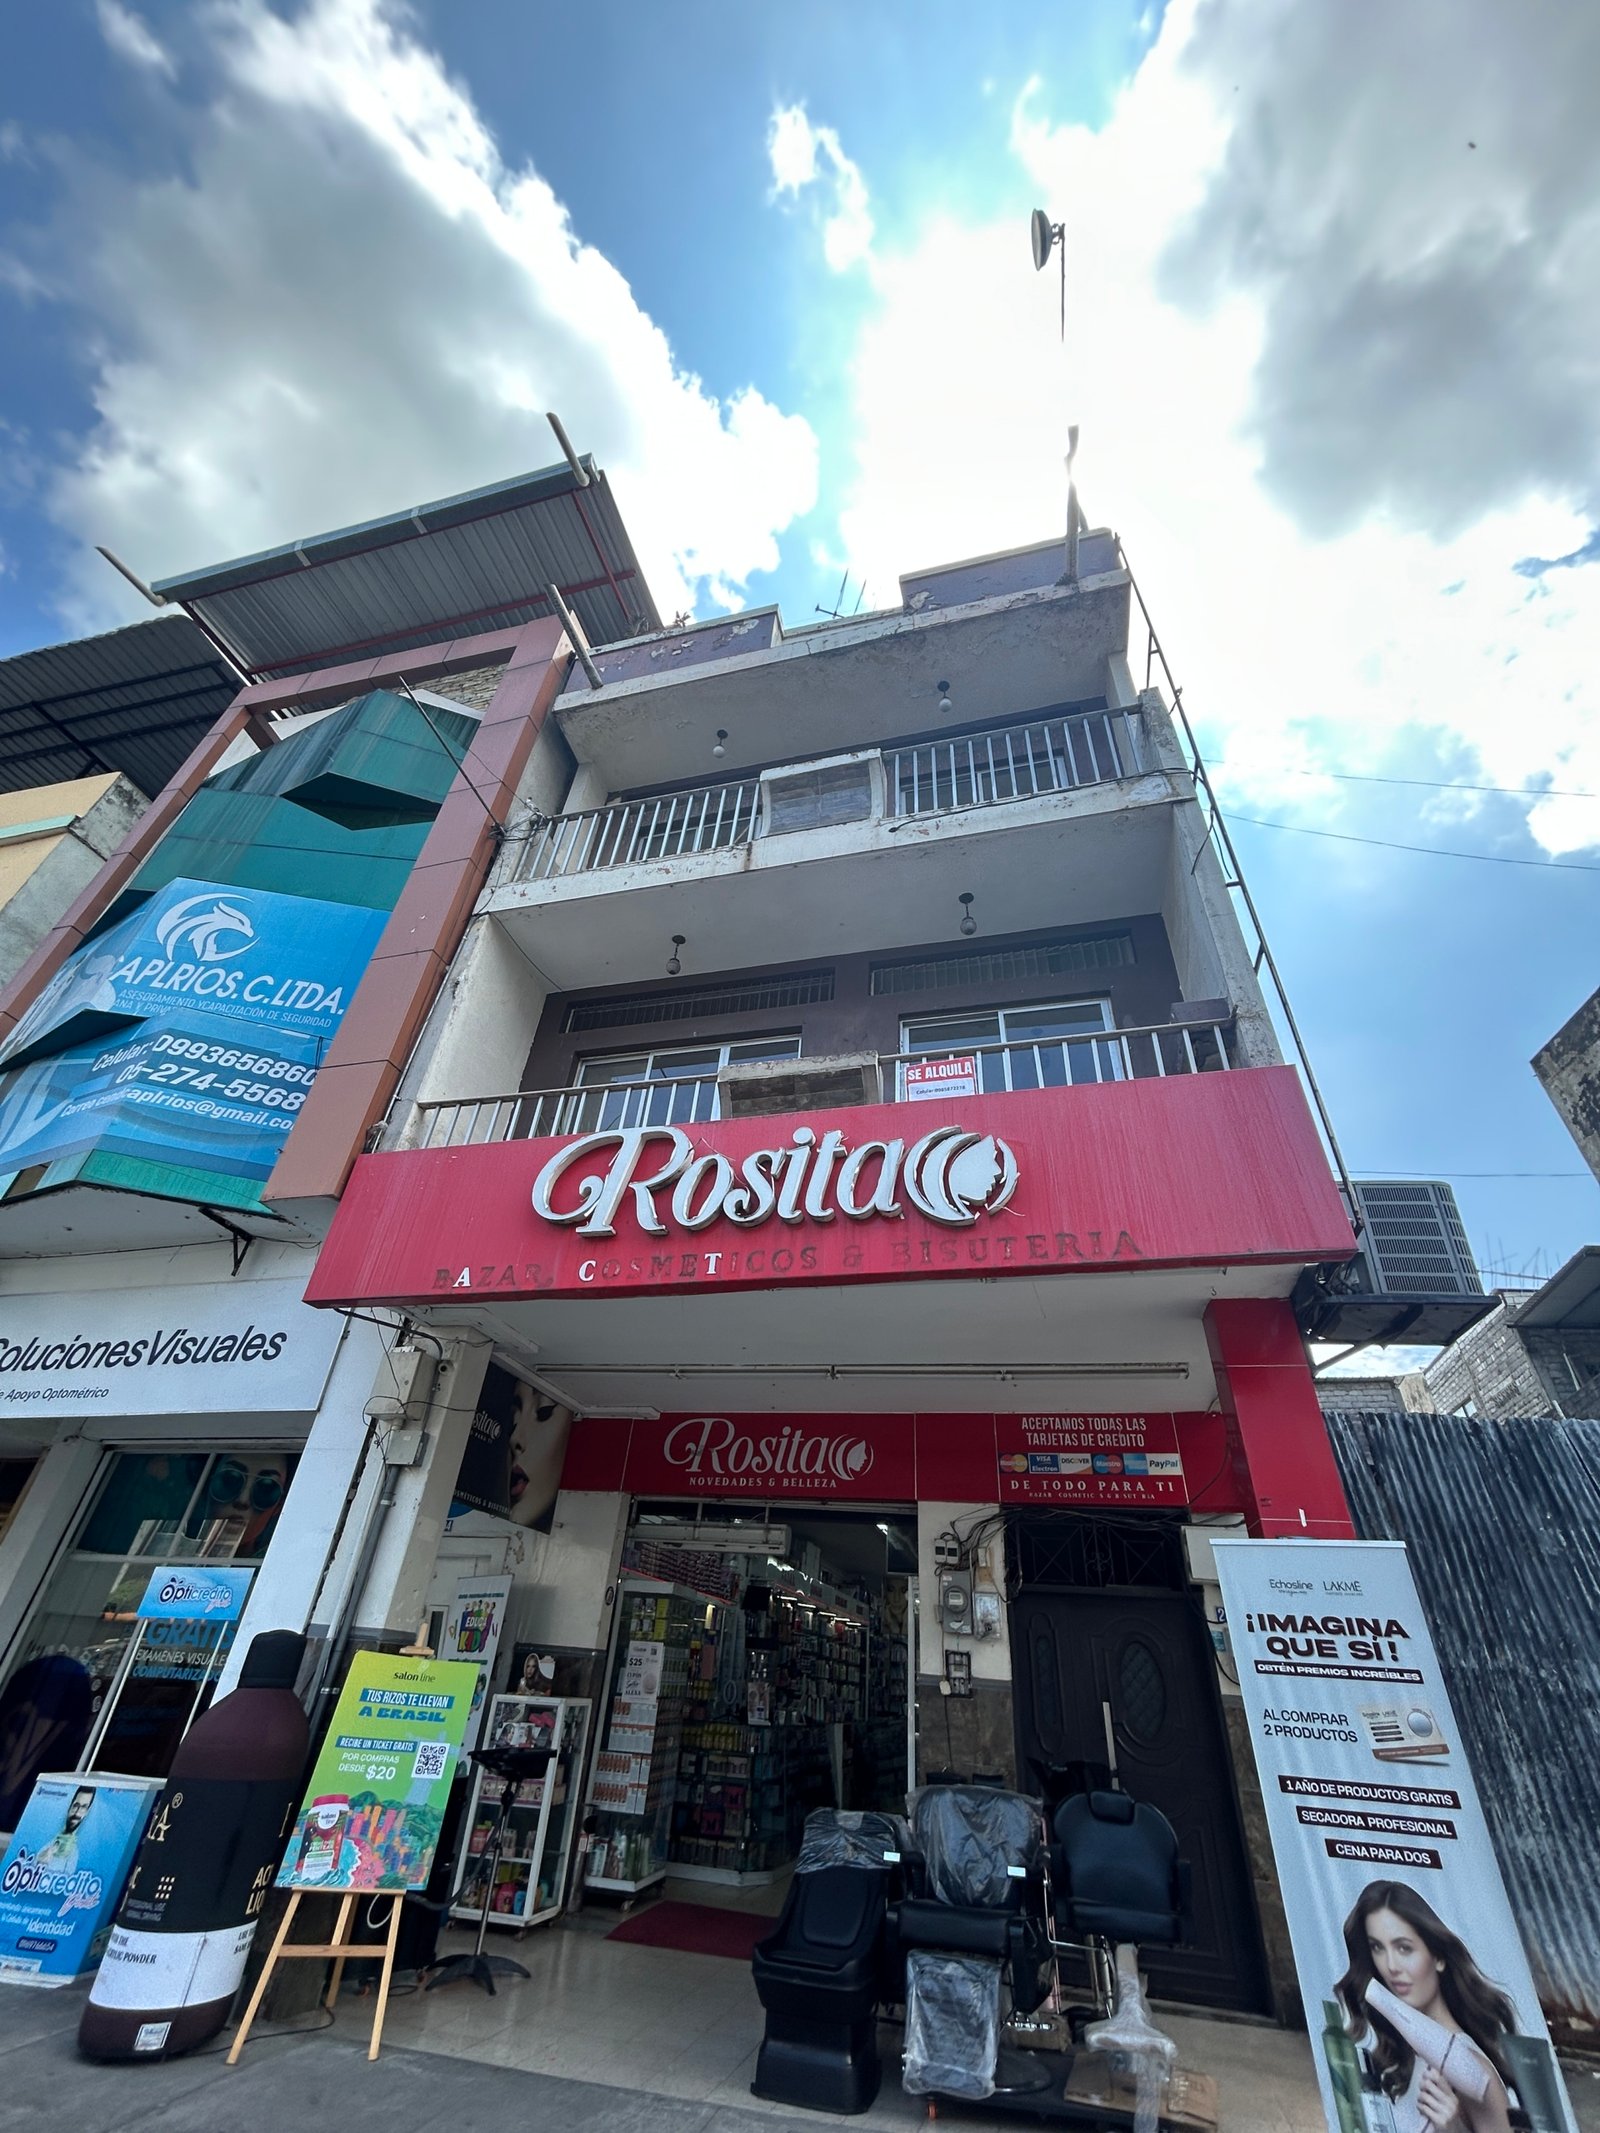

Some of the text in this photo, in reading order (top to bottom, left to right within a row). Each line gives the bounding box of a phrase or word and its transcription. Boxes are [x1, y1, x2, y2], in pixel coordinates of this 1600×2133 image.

[267, 1009, 279, 1021] DE
[281, 1012, 333, 1029] SEGURIDAD
[92, 1034, 318, 1087] Celular: 0993656860
[908, 1061, 973, 1081] SE ALQUILA
[116, 1059, 307, 1112] 05-274-5568
[531, 1125, 904, 1237] Rosita
[578, 1247, 818, 1283] COSMETICOS
[891, 1230, 1143, 1267] BISUTERIA
[5, 1388, 41, 1402] Apoyo
[42, 1386, 110, 1400] Optométrico
[1021, 1417, 1146, 1431] ACEPTAMOS TODAS LAS
[663, 1418, 830, 1475] Rosita
[1026, 1432, 1079, 1447] TARJETAS
[1081, 1433, 1095, 1447] DE
[1096, 1460, 1121, 1468] Maestro
[1149, 1459, 1178, 1469] PayPal
[689, 1476, 837, 1488] NOVEDADES & BELLEZA
[1011, 1480, 1174, 1492] DE TODO PARA TI
[159, 1577, 232, 1603] Opticredito
[1269, 1578, 1314, 1591] Echosline
[1246, 1613, 1411, 1639] ¡IMAGINA
[1266, 1636, 1340, 1660] QUE
[393, 1671, 436, 1683] salon line
[1257, 1662, 1421, 1681] OBTÉN PREMIOS INCREÍBLES
[366, 1689, 450, 1708] TUS RIZOS TE LLEVAN
[358, 1706, 446, 1723] A BRASIL
[1263, 1708, 1280, 1721] AL
[1280, 1709, 1349, 1726] COMPRAR
[1263, 1724, 1359, 1743] 2 PRODUCTOS
[339, 1737, 415, 1752] RECIBE UN TICKET GRATIS
[342, 1752, 400, 1763] POR COMPRAS
[338, 1763, 397, 1780] DESDE $20
[1286, 1778, 1454, 1806] 1 AÑO DE PRODUCTOS GRATIS
[1301, 1809, 1453, 1835] SECADORA PROFESIONAL
[1335, 1843, 1432, 1865] CENA PARA DOS
[2, 1848, 102, 1897] Opticredito
[26, 1918, 76, 1937] Identidad
[122, 1952, 157, 1965] POWDER
